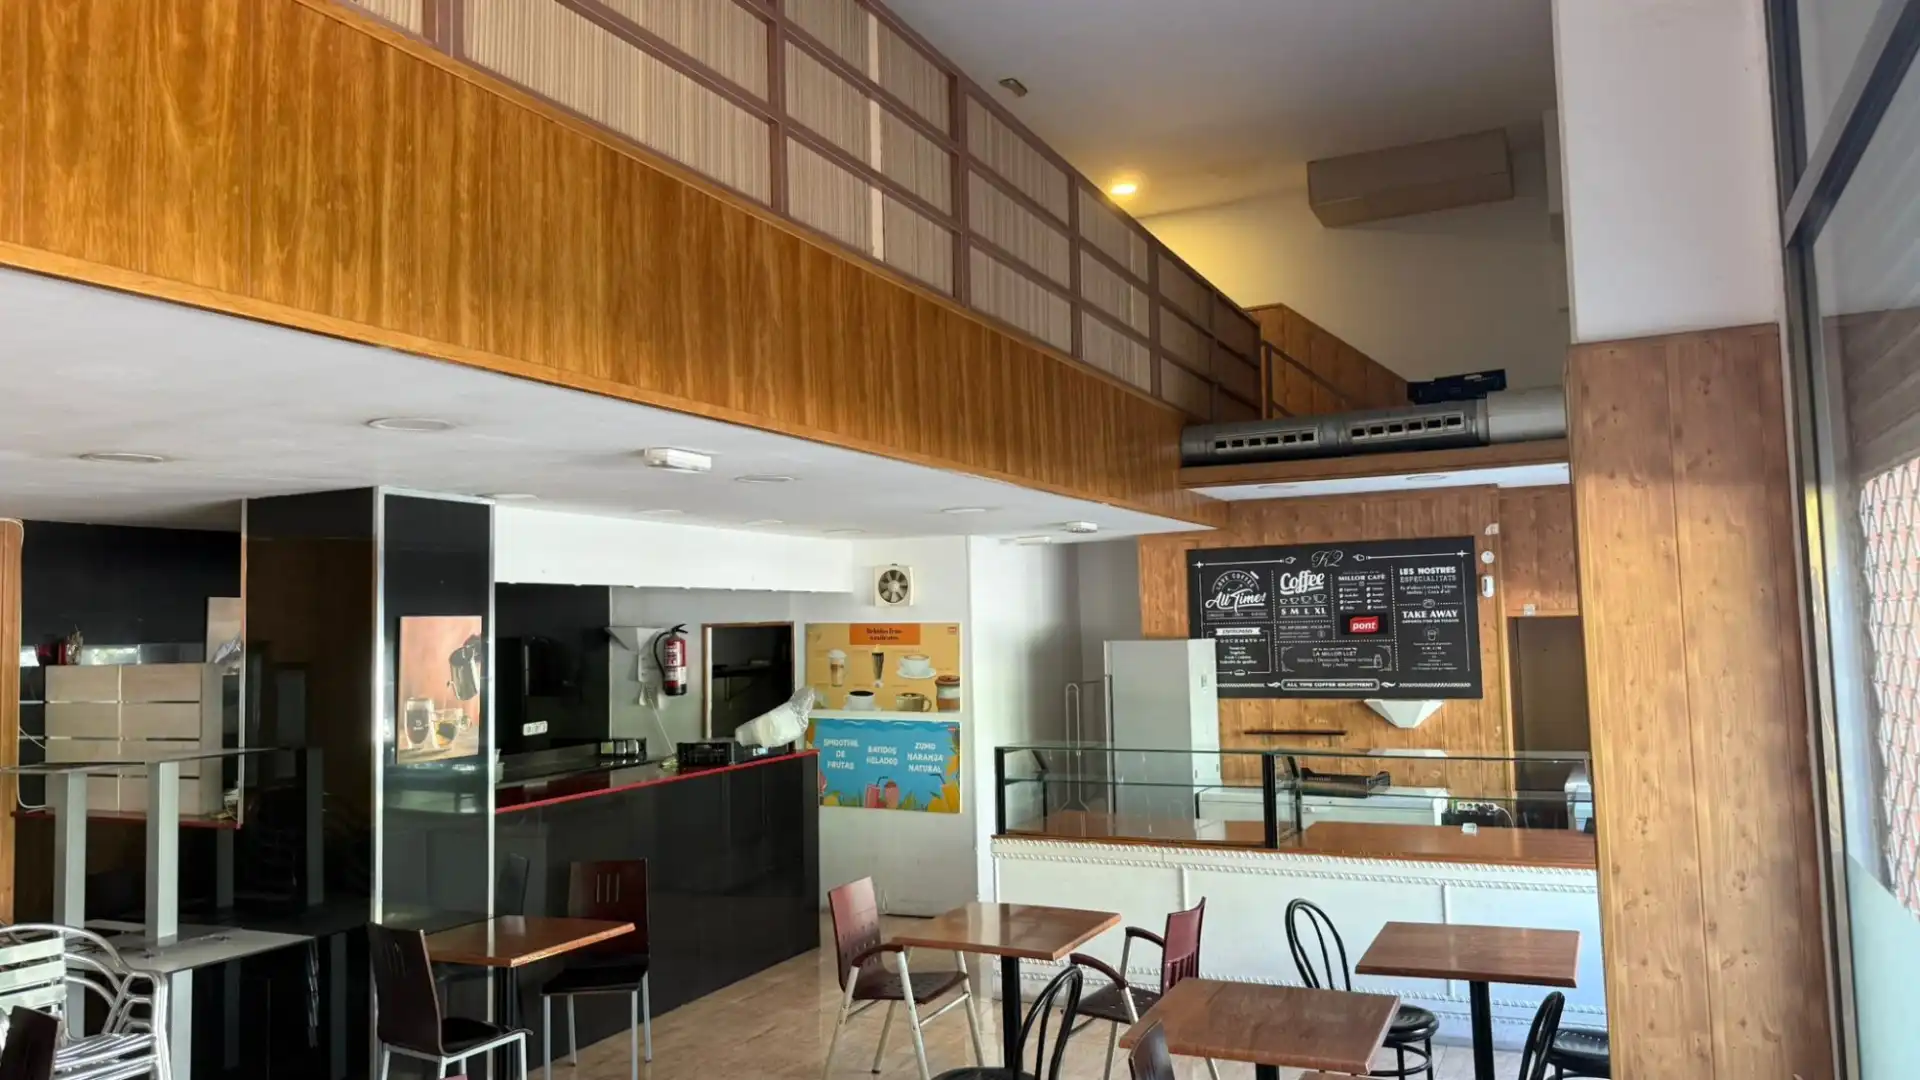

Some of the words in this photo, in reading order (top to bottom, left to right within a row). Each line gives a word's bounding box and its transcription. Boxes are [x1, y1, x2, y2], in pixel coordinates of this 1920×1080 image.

[1399, 567, 1415, 576] LES
[1417, 566, 1457, 575] NOSTRES
[1280, 570, 1326, 594] Coffee
[1399, 575, 1457, 583] ESPECIALITATS
[1205, 591, 1233, 609] All
[1290, 607, 1299, 615] M
[1304, 607, 1310, 615] L
[1314, 606, 1327, 614] XL
[1402, 610, 1427, 618] TAKE
[1430, 609, 1458, 618] AWAY
[1352, 621, 1376, 631] pont
[867, 745, 897, 754] BATIDOS
[915, 742, 936, 750] ZUMO
[835, 750, 846, 758] DE
[907, 752, 944, 762] NARANJA
[827, 760, 855, 770] FRUTAS
[866, 757, 898, 766] HELADOS
[908, 764, 942, 773] NATURAL
